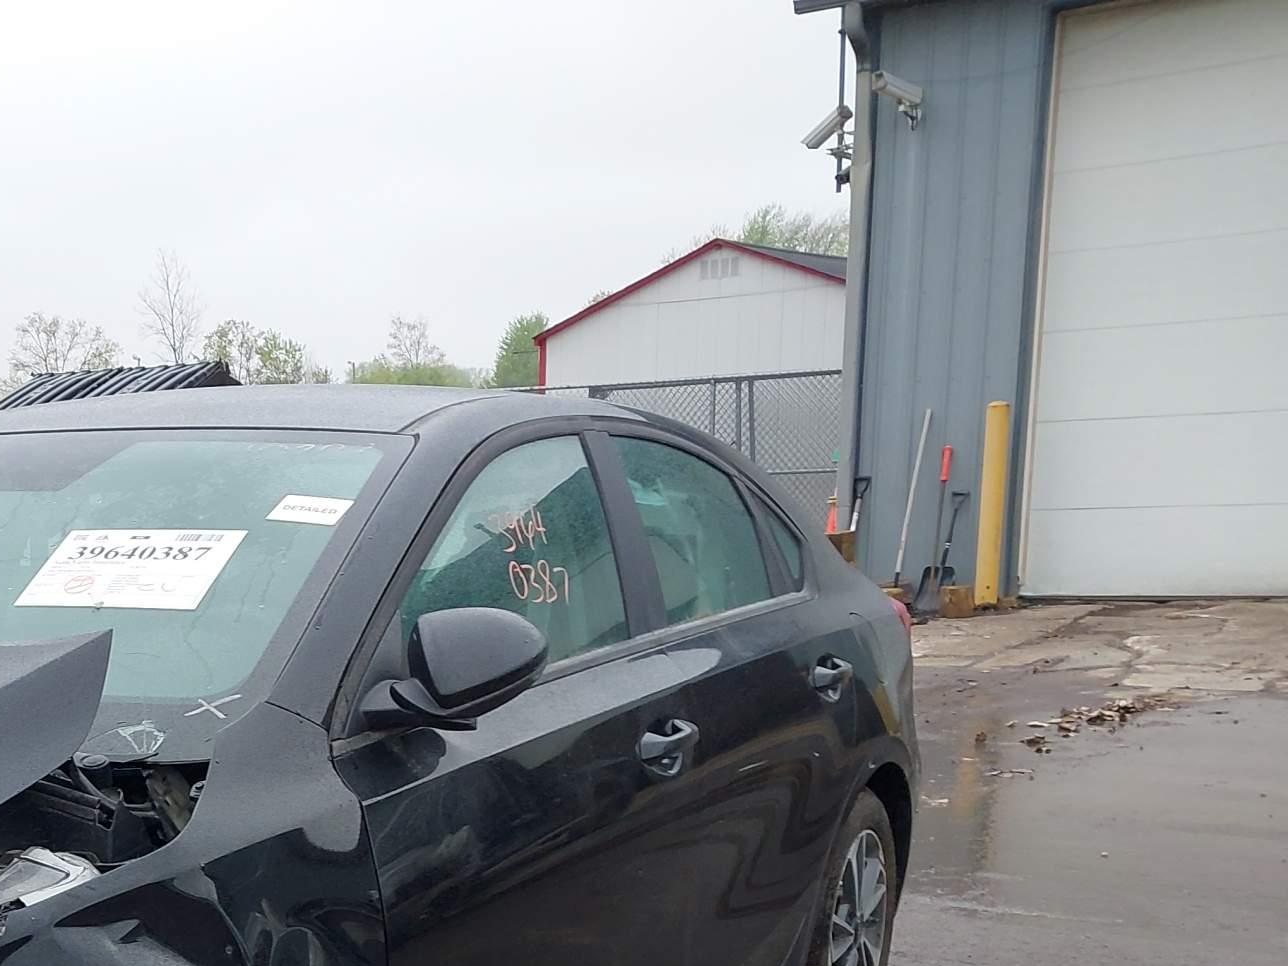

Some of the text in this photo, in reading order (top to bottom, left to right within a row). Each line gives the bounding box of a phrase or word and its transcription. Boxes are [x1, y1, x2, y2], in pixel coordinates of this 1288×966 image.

[282, 504, 339, 514] DETAILED
[67, 545, 213, 561] 39640387
[508, 559, 570, 606] 0387
